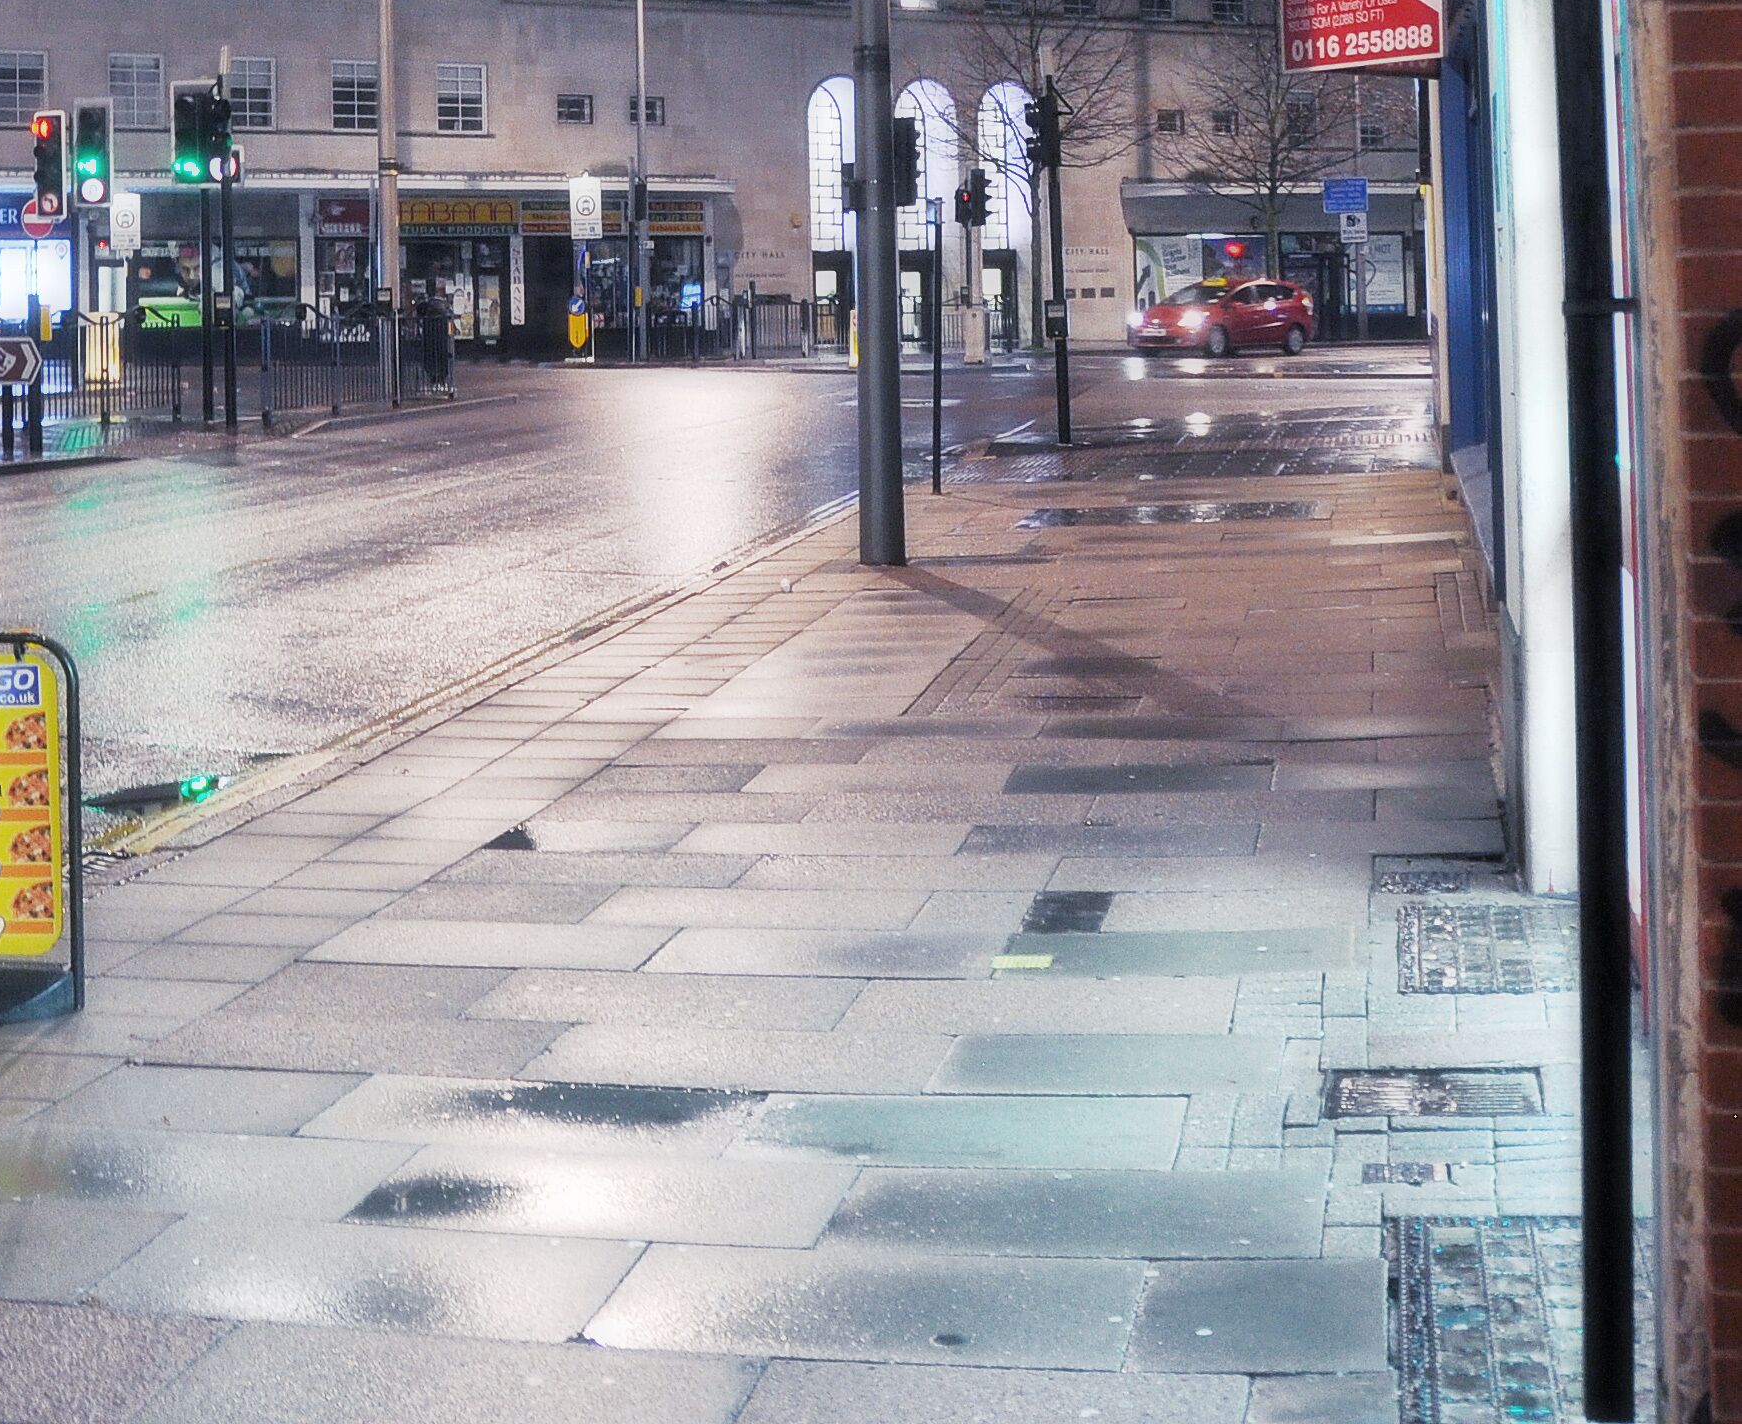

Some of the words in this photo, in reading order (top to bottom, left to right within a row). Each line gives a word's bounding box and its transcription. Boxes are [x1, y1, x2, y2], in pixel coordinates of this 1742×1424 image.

[1317, 3, 1329, 15] For
[1330, 1, 1338, 13] A
[1370, 8, 1385, 22] FT)
[1291, 36, 1340, 62] 0116
[1345, 24, 1434, 56] 2558888
[402, 226, 441, 234] TURAL
